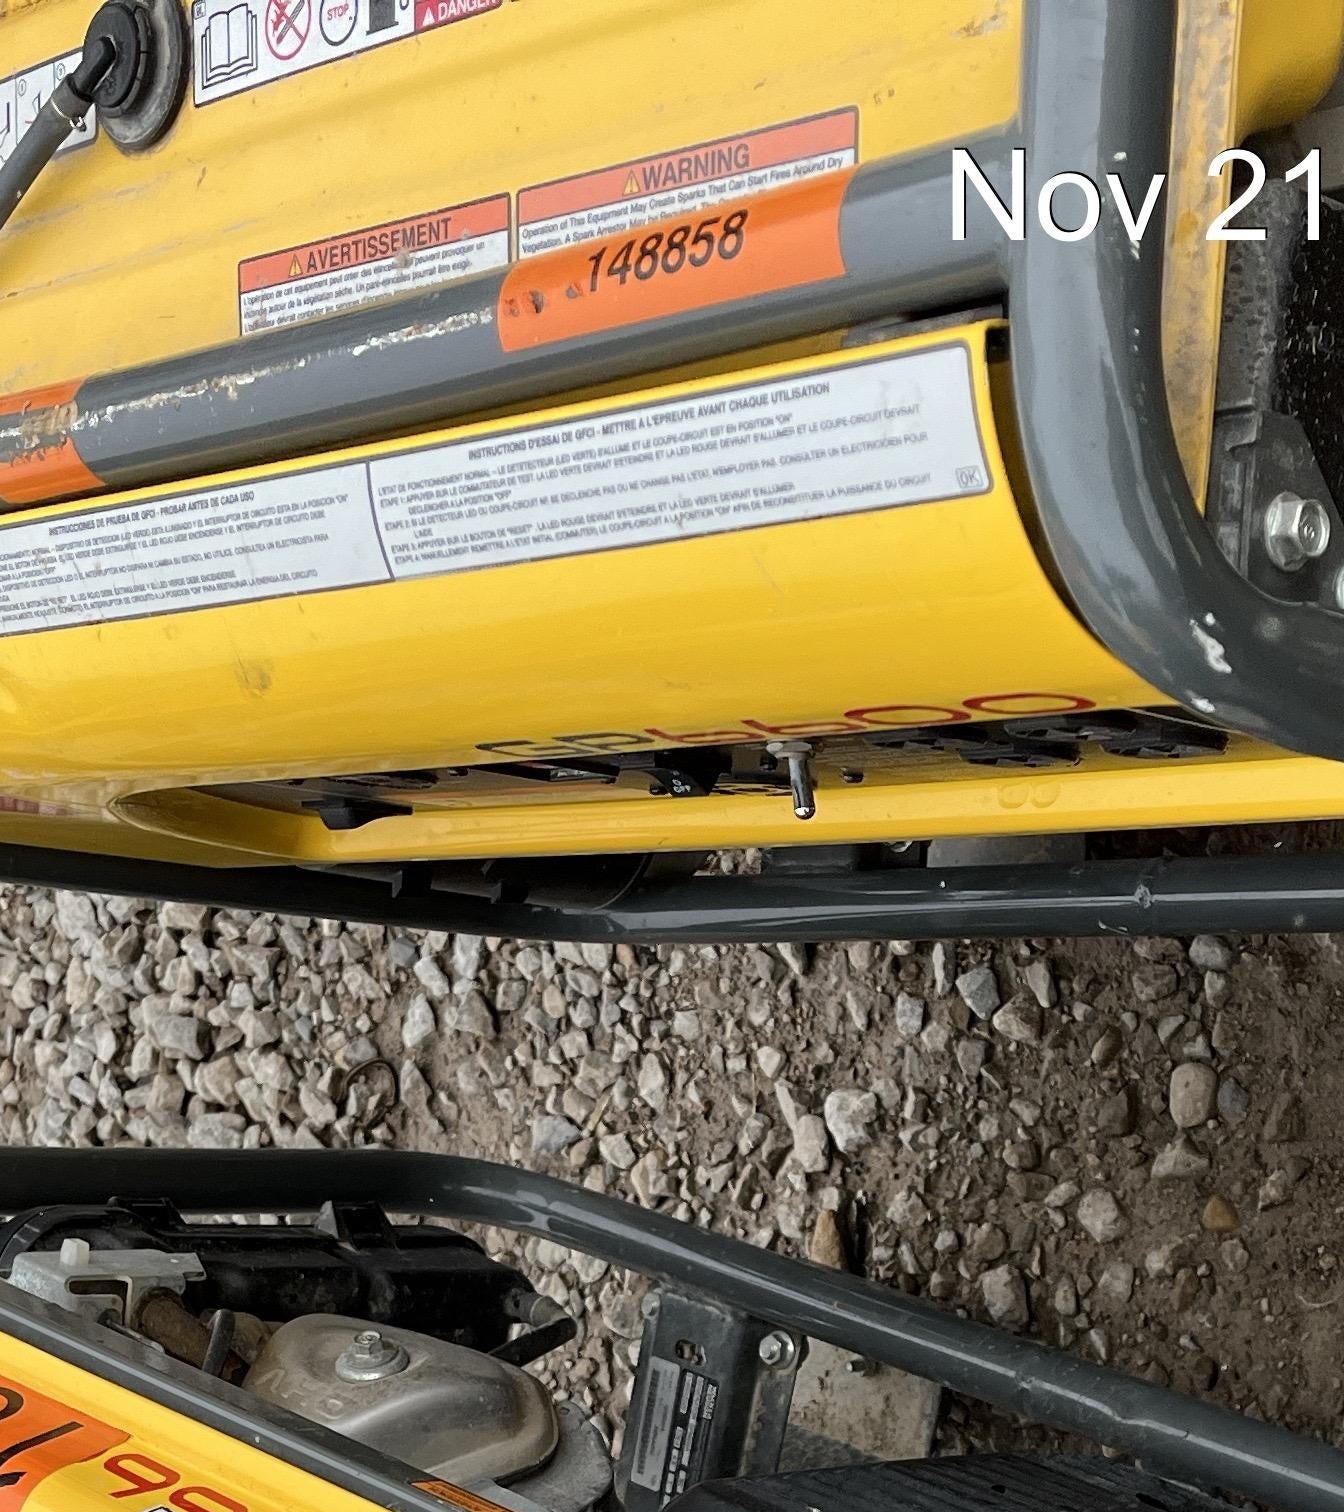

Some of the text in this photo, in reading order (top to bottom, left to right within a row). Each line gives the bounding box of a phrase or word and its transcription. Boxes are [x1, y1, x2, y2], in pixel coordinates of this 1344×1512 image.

[327, 6, 349, 21] STOP
[643, 140, 749, 195] WARNING
[306, 216, 451, 274] AVERTISSEMENT
[588, 209, 749, 293] 148858
